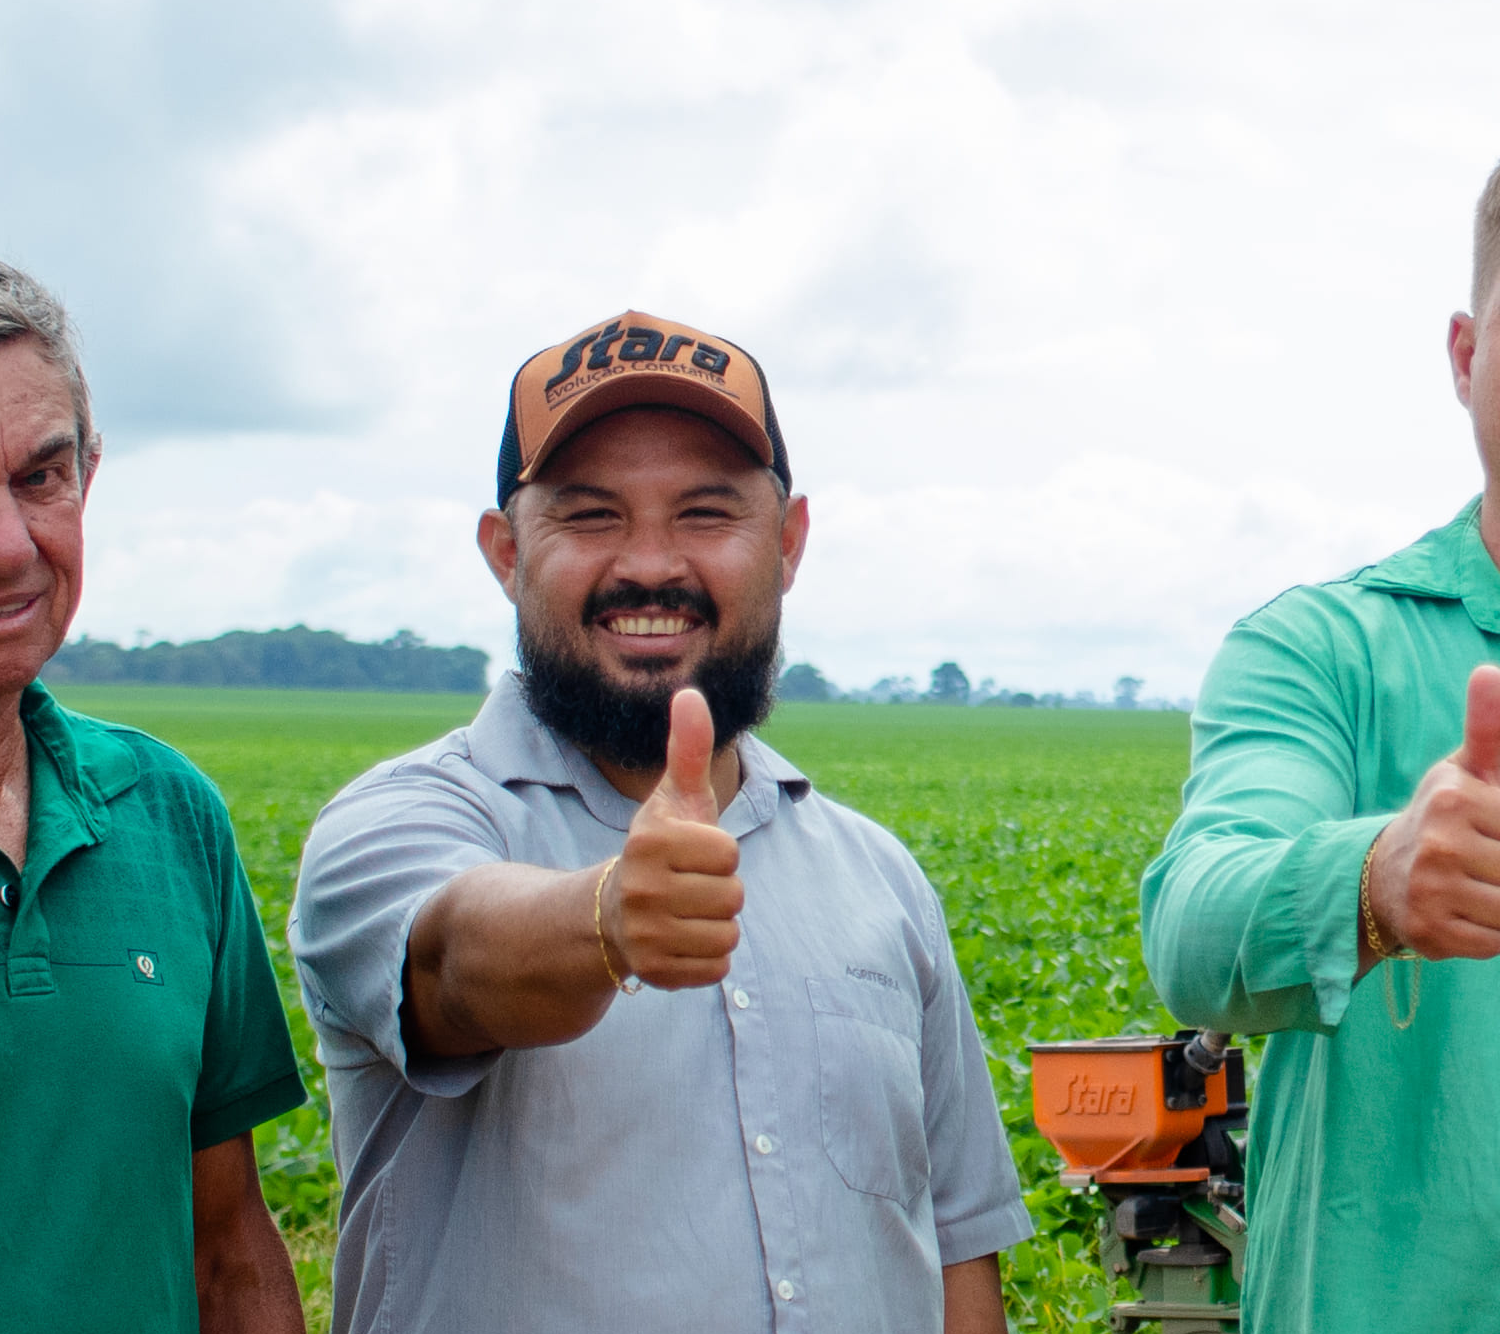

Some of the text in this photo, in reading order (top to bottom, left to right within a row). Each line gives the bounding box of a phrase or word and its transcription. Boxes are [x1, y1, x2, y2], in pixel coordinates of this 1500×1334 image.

[544, 320, 730, 392] Stara
[546, 361, 726, 403] Evolução Constante
[1055, 1073, 1137, 1115] Stara
